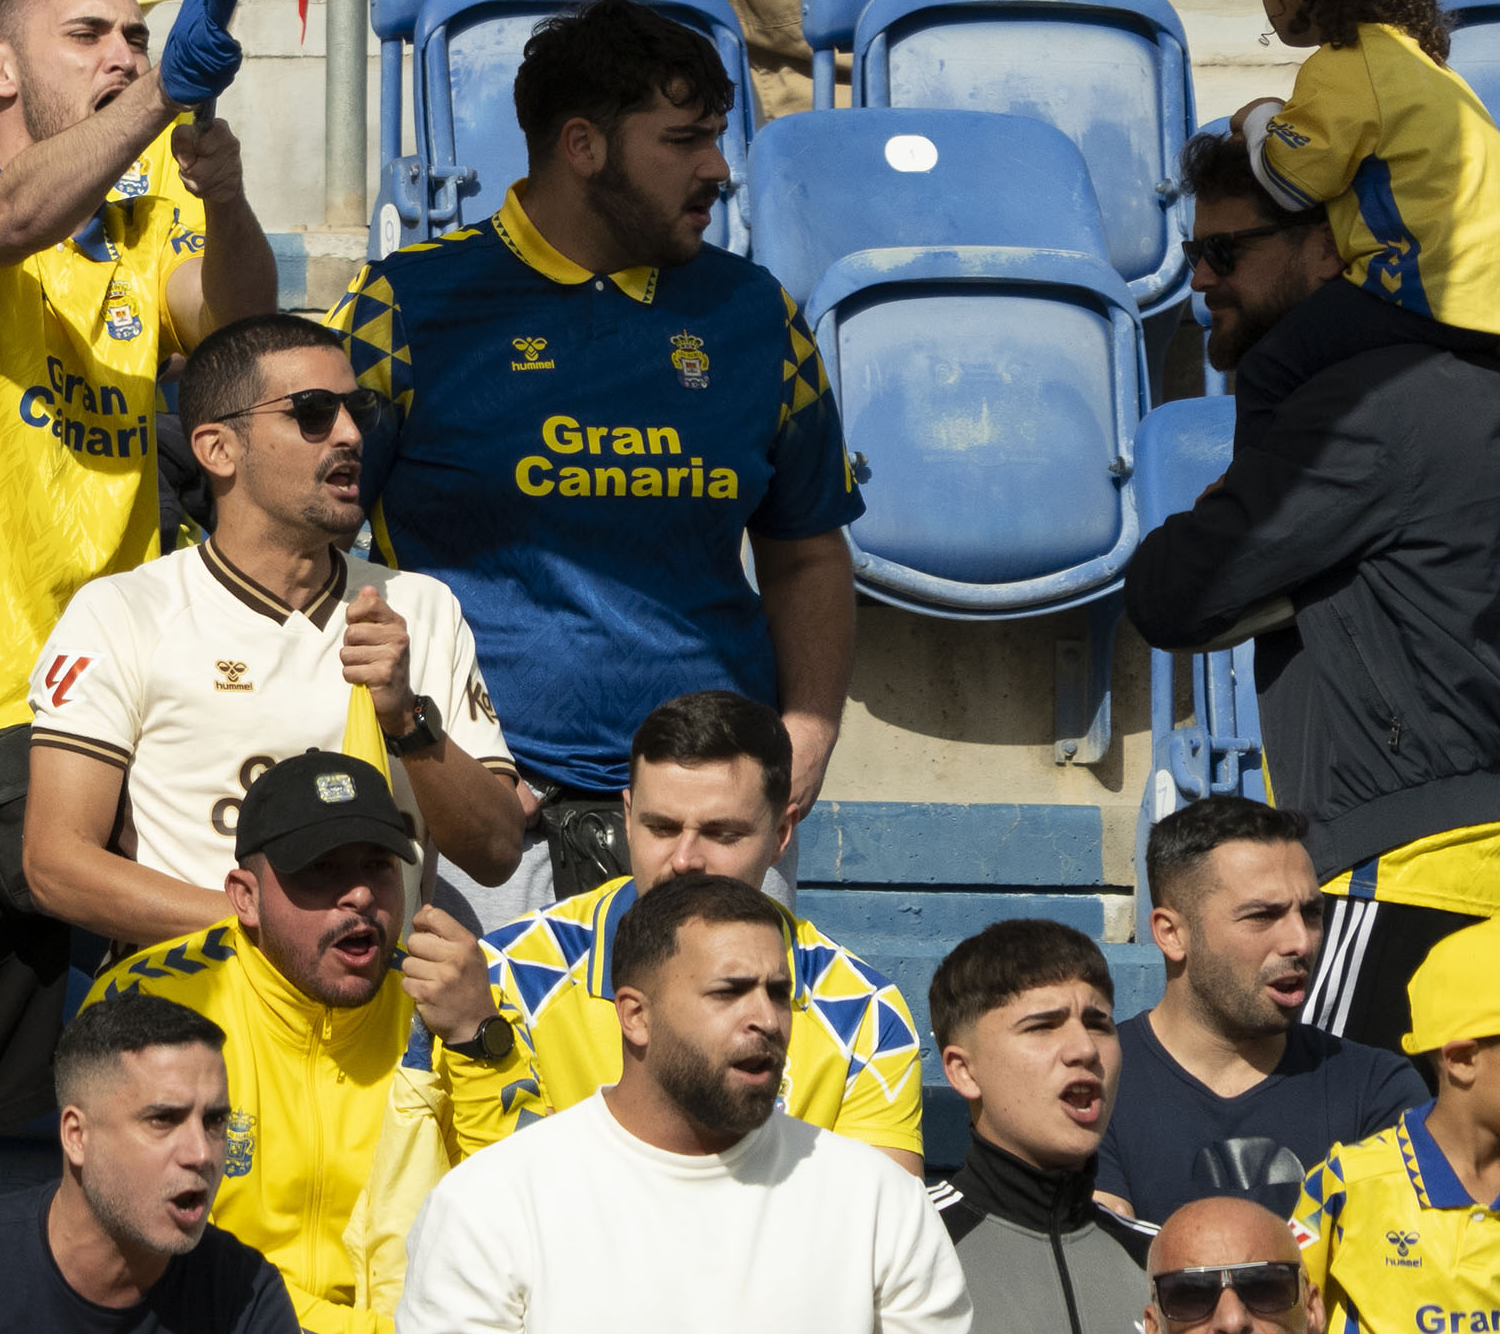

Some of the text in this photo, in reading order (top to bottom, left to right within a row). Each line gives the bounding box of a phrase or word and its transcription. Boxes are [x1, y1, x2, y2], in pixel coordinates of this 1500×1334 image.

[46, 354, 128, 417] Gran
[511, 359, 556, 372] hummel
[19, 384, 149, 459] Canari
[540, 414, 683, 457] Gran
[514, 455, 740, 501] Canaria
[215, 680, 254, 692] hummel
[1385, 1256, 1424, 1268] hummel
